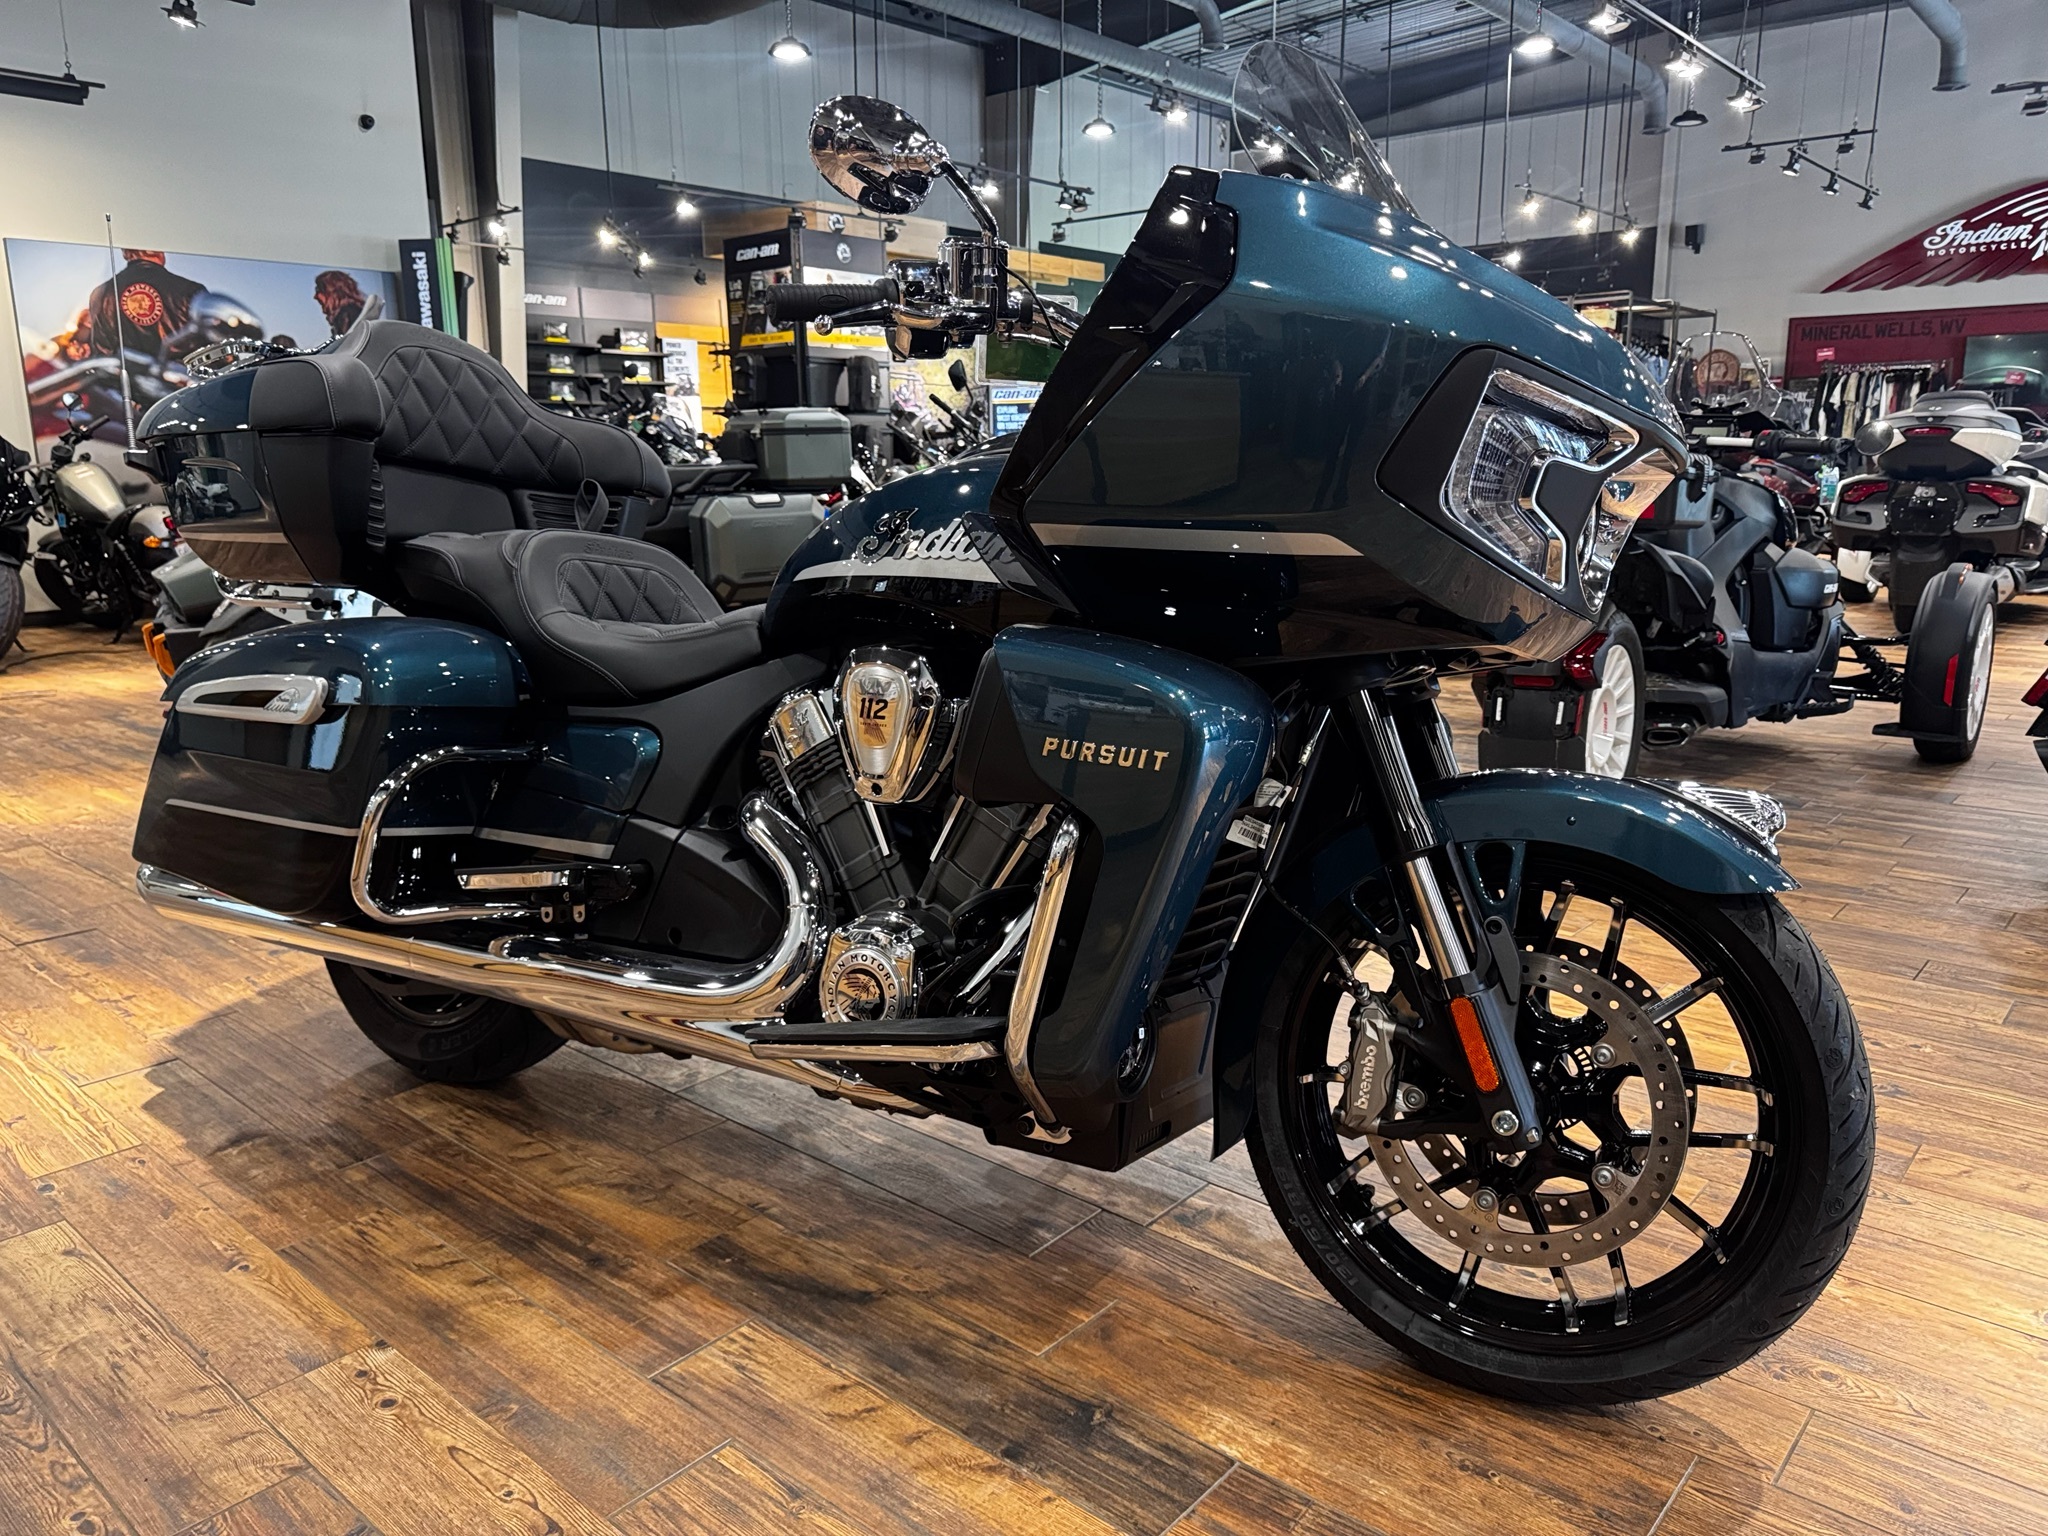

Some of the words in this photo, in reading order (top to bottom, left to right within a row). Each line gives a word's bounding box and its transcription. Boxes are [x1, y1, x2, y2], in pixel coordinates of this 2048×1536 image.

[1923, 220, 2033, 249] Indian
[1926, 241, 2028, 257] MOTORCYCLE
[735, 243, 781, 262] can-am
[411, 251, 434, 329] awasaki
[523, 293, 568, 306] an-am
[1800, 323, 1872, 341] MINERAL
[1875, 319, 1936, 338] WELLS,
[1940, 318, 1967, 334] WV
[856, 507, 1016, 565] Indian
[859, 698, 889, 720] 112
[1041, 736, 1170, 771] PURSUIT
[827, 961, 846, 1016] INDIAN
[850, 953, 897, 1020] MOTORCYCL
[1353, 1044, 1377, 1110] brembo
[1298, 1212, 1360, 1287] 130/60
